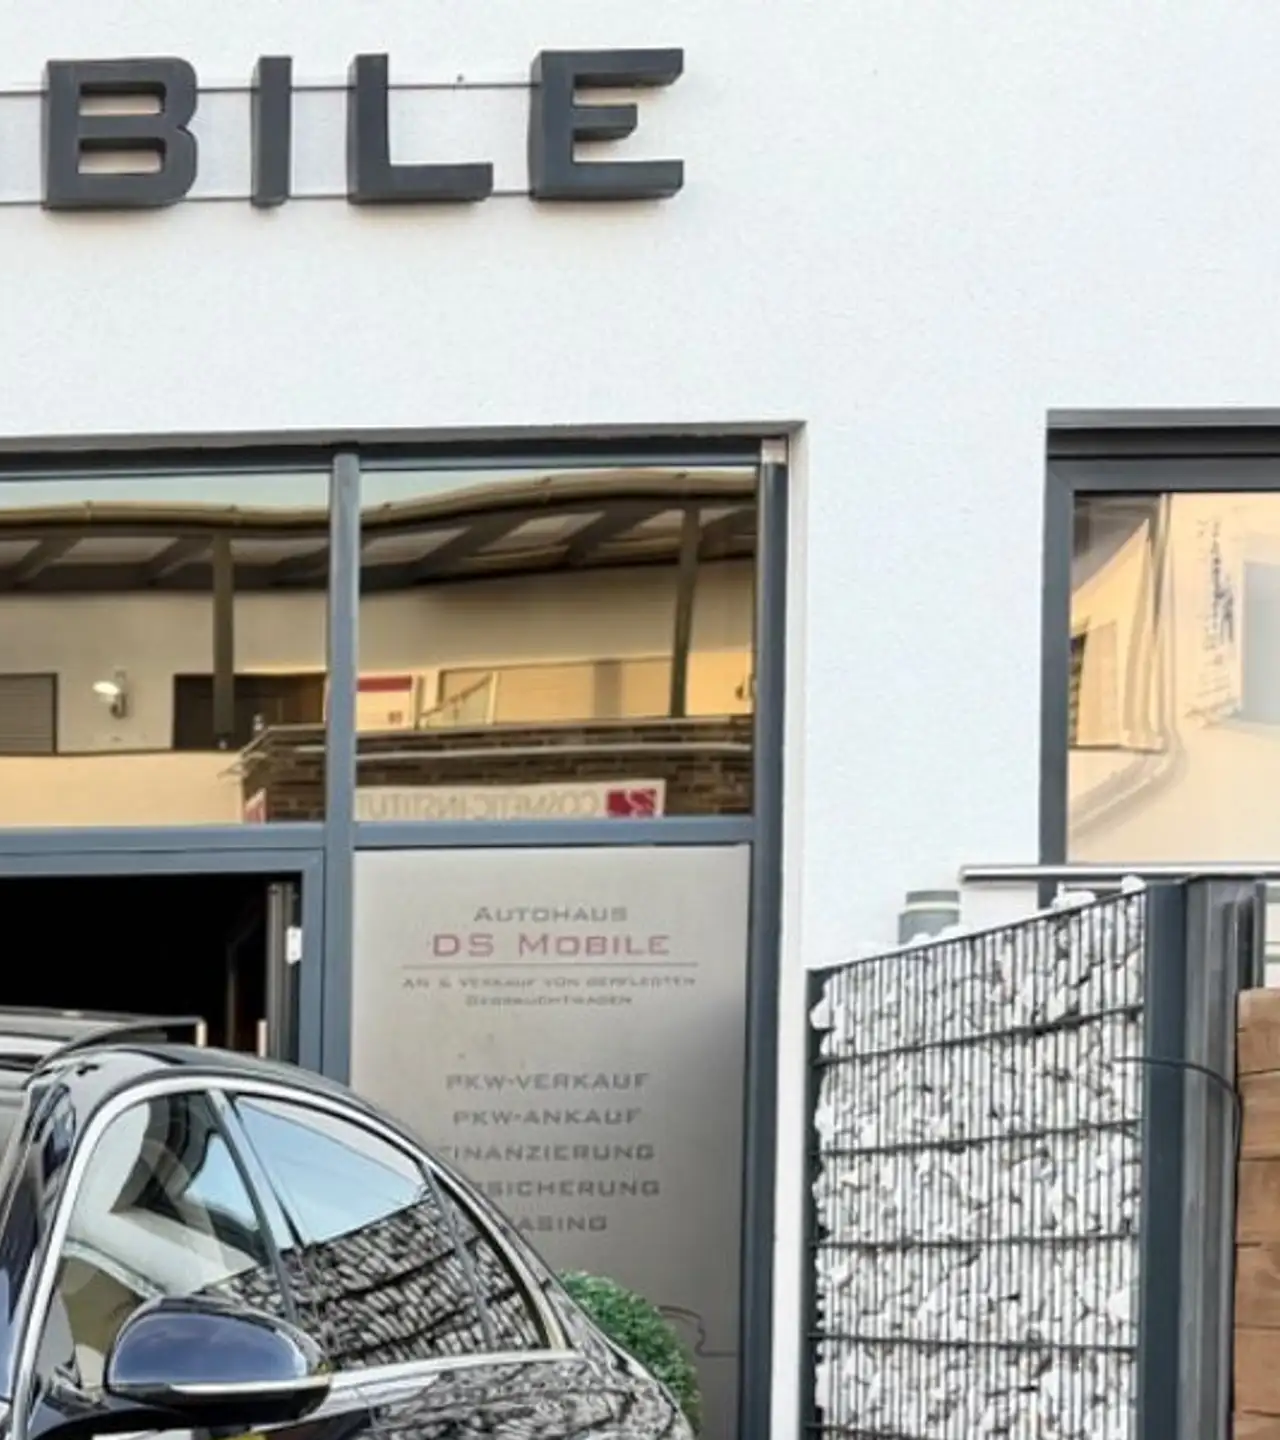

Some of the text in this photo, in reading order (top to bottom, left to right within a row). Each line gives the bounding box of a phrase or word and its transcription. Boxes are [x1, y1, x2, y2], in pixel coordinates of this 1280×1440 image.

[473, 906, 628, 923] AUTOHAUS
[432, 932, 671, 958] DS MOBILE
[445, 1072, 650, 1091] PKW-VERKAUF
[452, 1107, 643, 1126] PKW-ANKAUF
[514, 1214, 608, 1232] ASING
